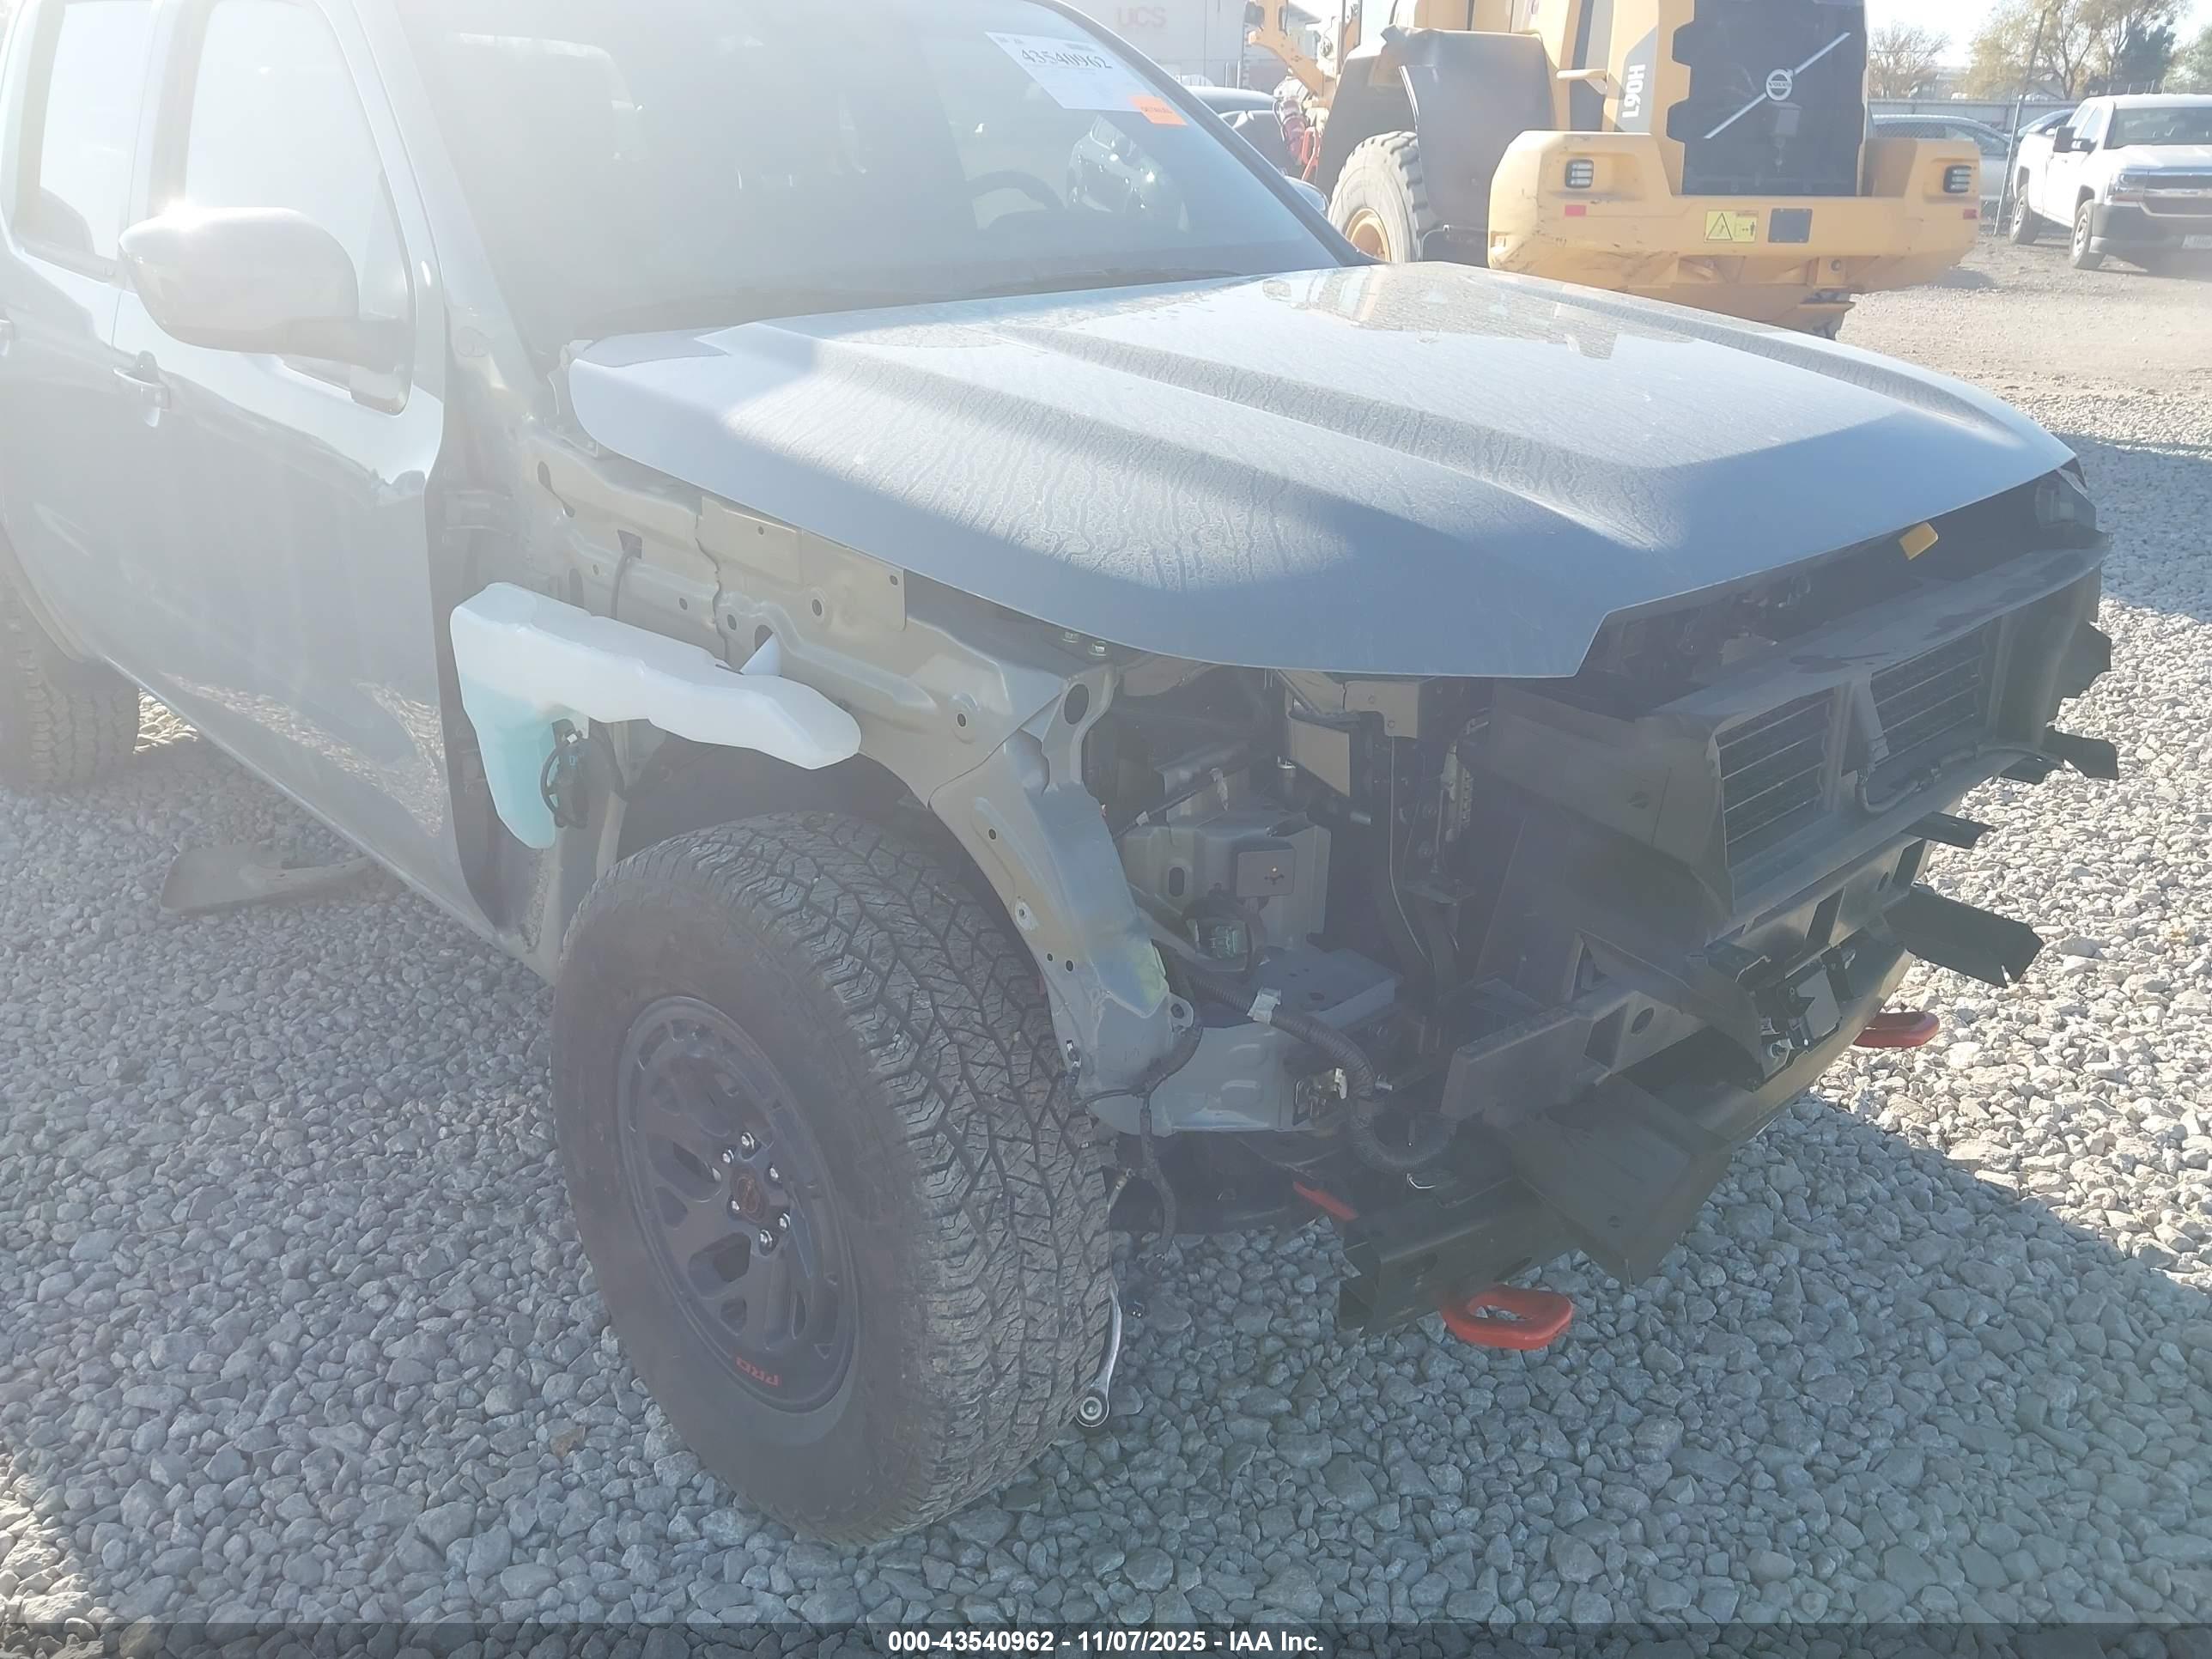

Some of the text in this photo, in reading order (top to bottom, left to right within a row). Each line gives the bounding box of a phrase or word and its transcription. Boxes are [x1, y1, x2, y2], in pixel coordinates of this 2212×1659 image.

[1022, 49, 1113, 69] 43540962
[1622, 64, 1646, 118] L90H
[736, 1357, 779, 1387] PRO
